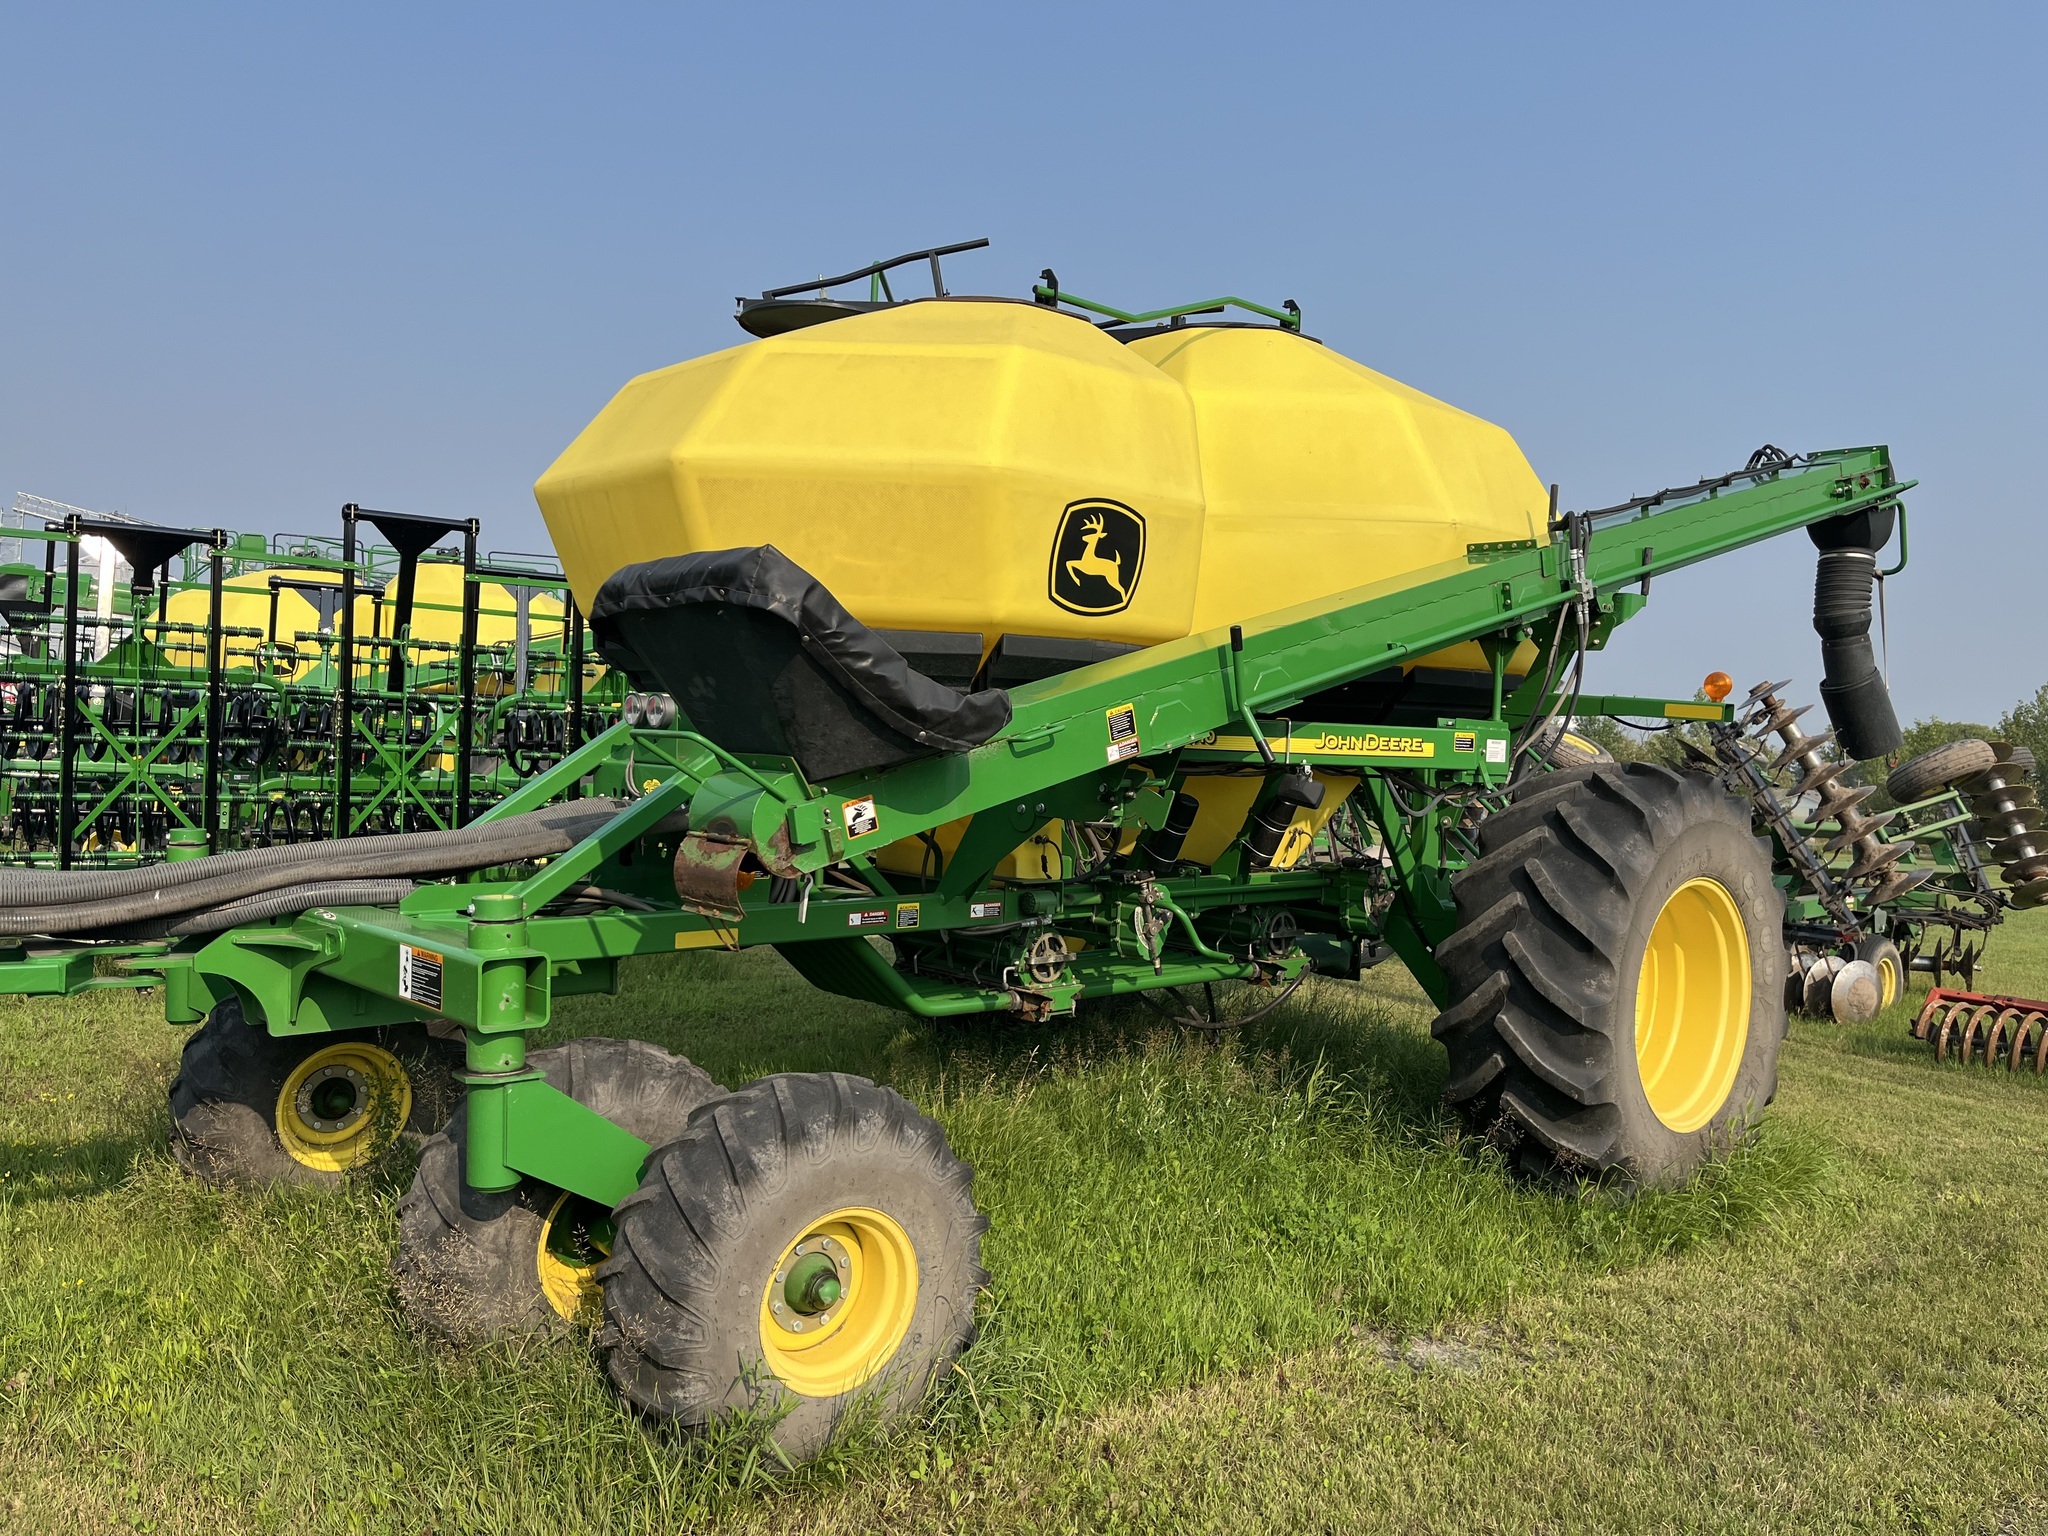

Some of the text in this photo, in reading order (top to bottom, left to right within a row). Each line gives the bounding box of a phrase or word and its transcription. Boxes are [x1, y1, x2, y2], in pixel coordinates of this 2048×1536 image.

[1315, 732, 1423, 752] JOHN DEERE
[421, 951, 438, 961] WARNING
